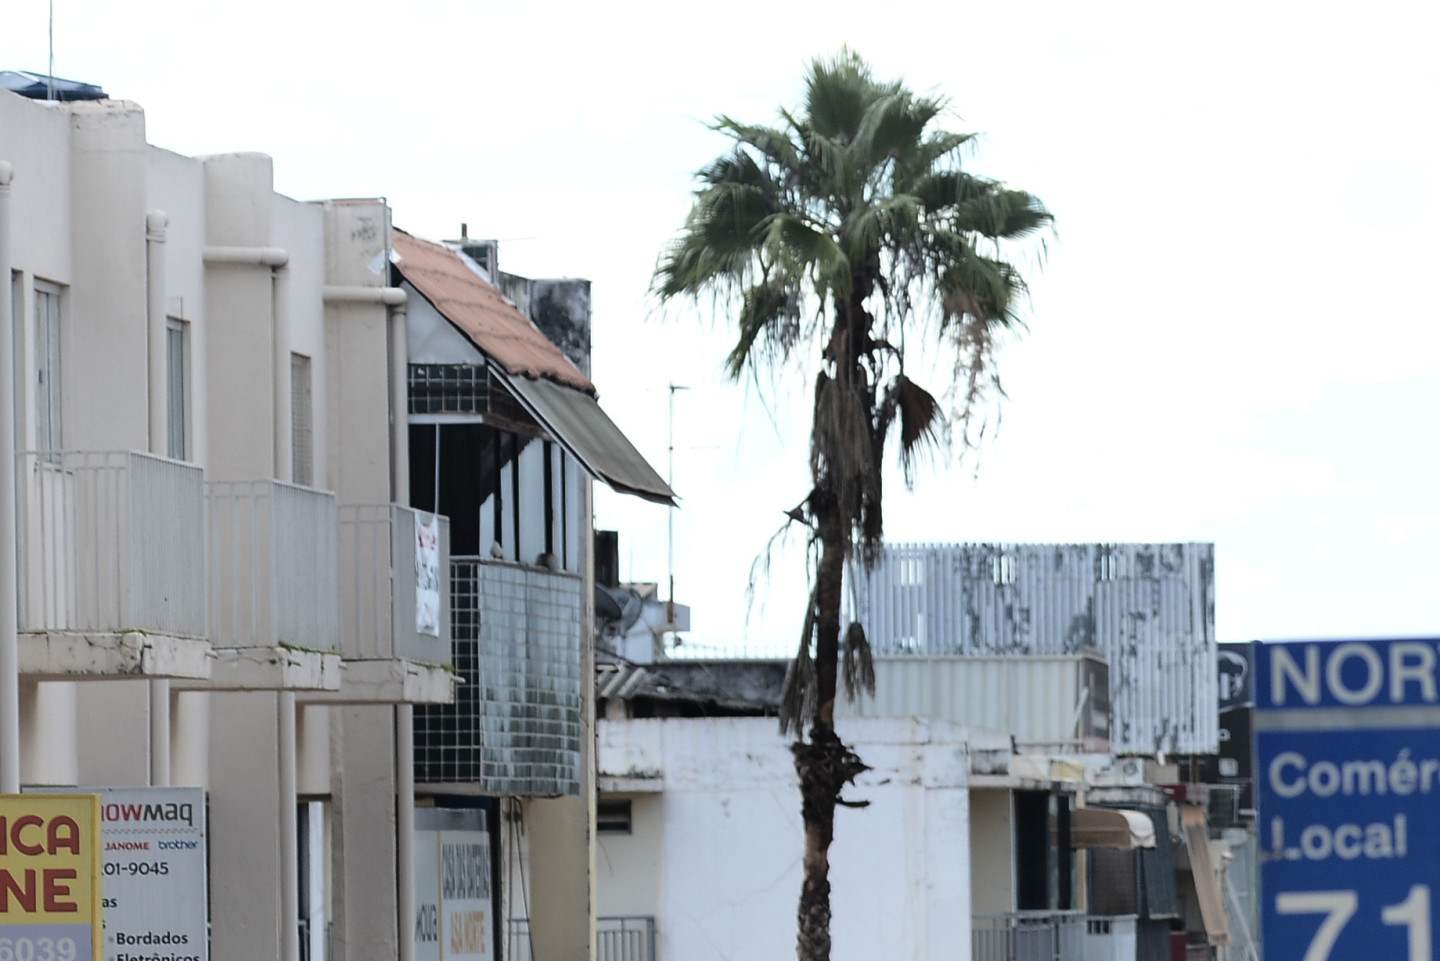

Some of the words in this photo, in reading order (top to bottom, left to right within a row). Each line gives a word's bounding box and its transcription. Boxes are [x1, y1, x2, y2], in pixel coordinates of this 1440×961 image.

[105, 841, 150, 851] JANOME
[158, 840, 198, 850] brother
[101, 862, 169, 876] 01-9045
[116, 932, 189, 946] Bordados
